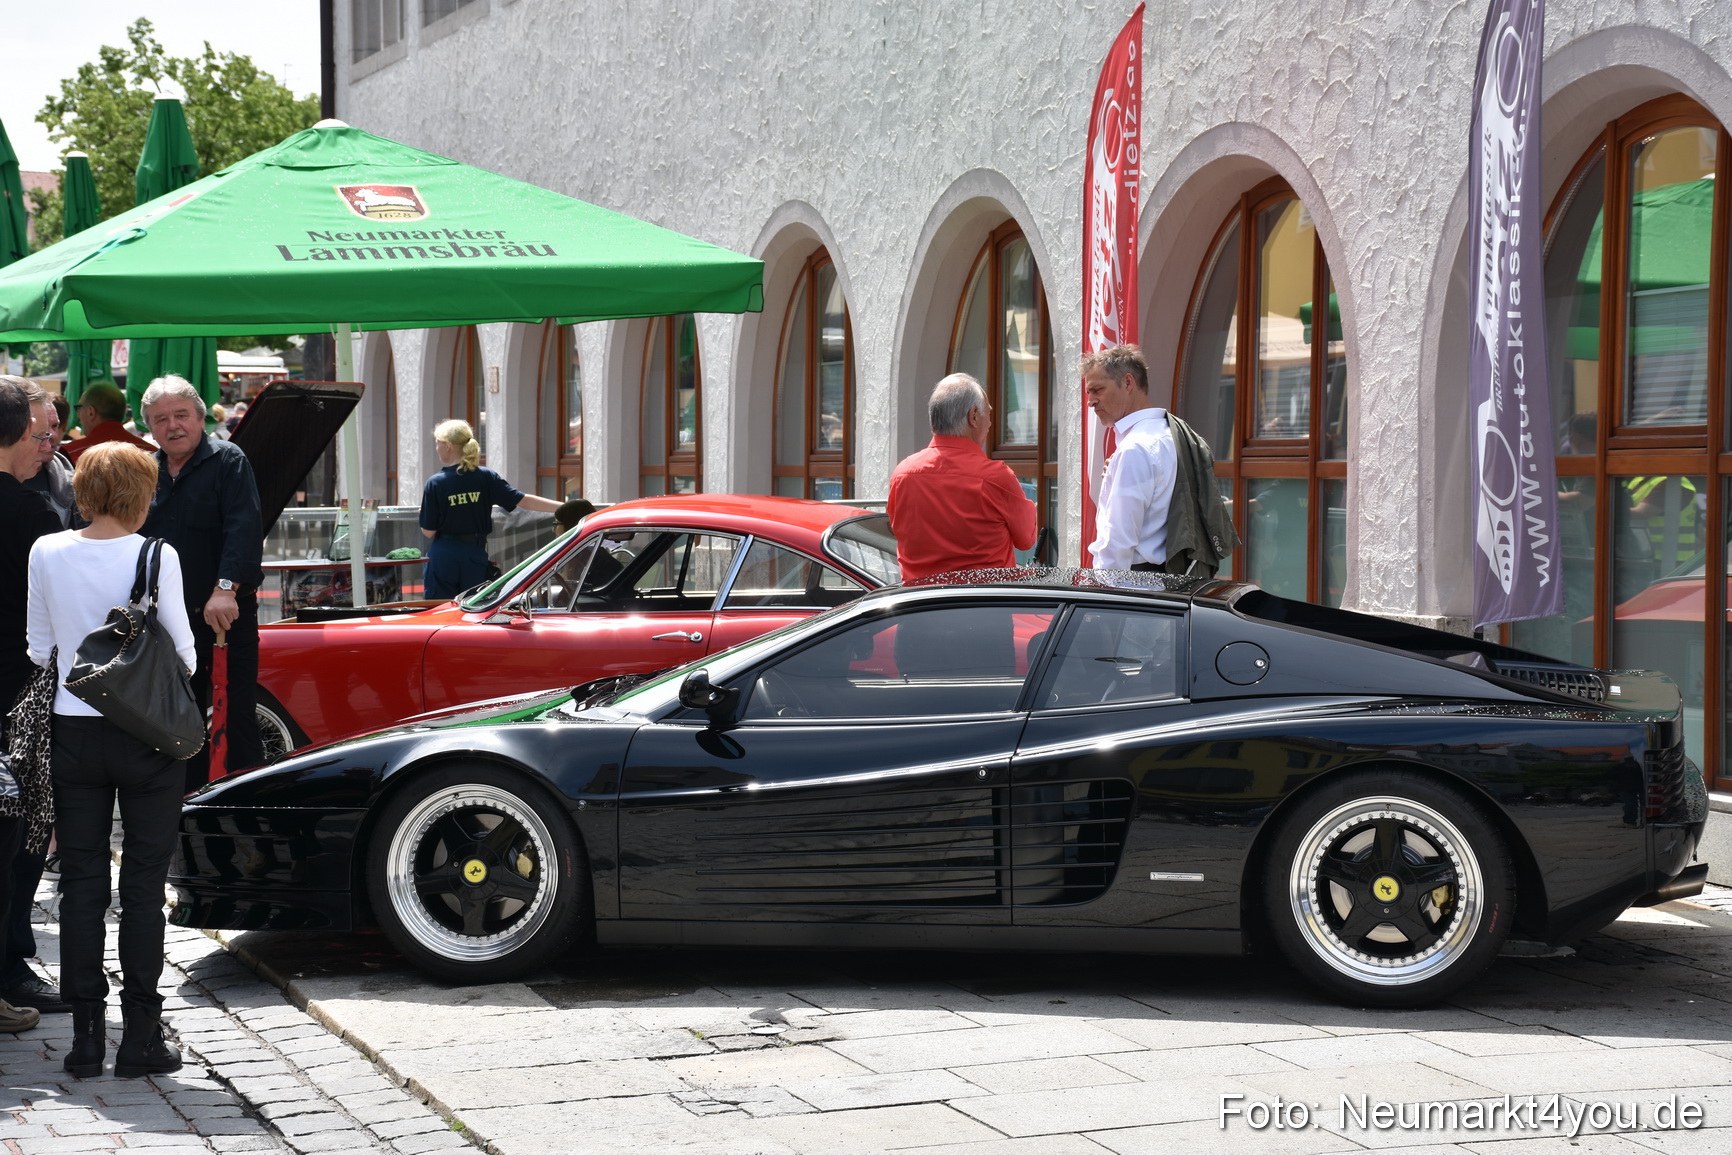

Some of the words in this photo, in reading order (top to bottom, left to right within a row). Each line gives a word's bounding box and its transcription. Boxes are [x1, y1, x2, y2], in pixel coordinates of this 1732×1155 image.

[377, 211, 412, 219] 1628
[306, 228, 507, 243] Neumarkter
[275, 241, 559, 262] Lammsbräu
[448, 491, 481, 507] THW
